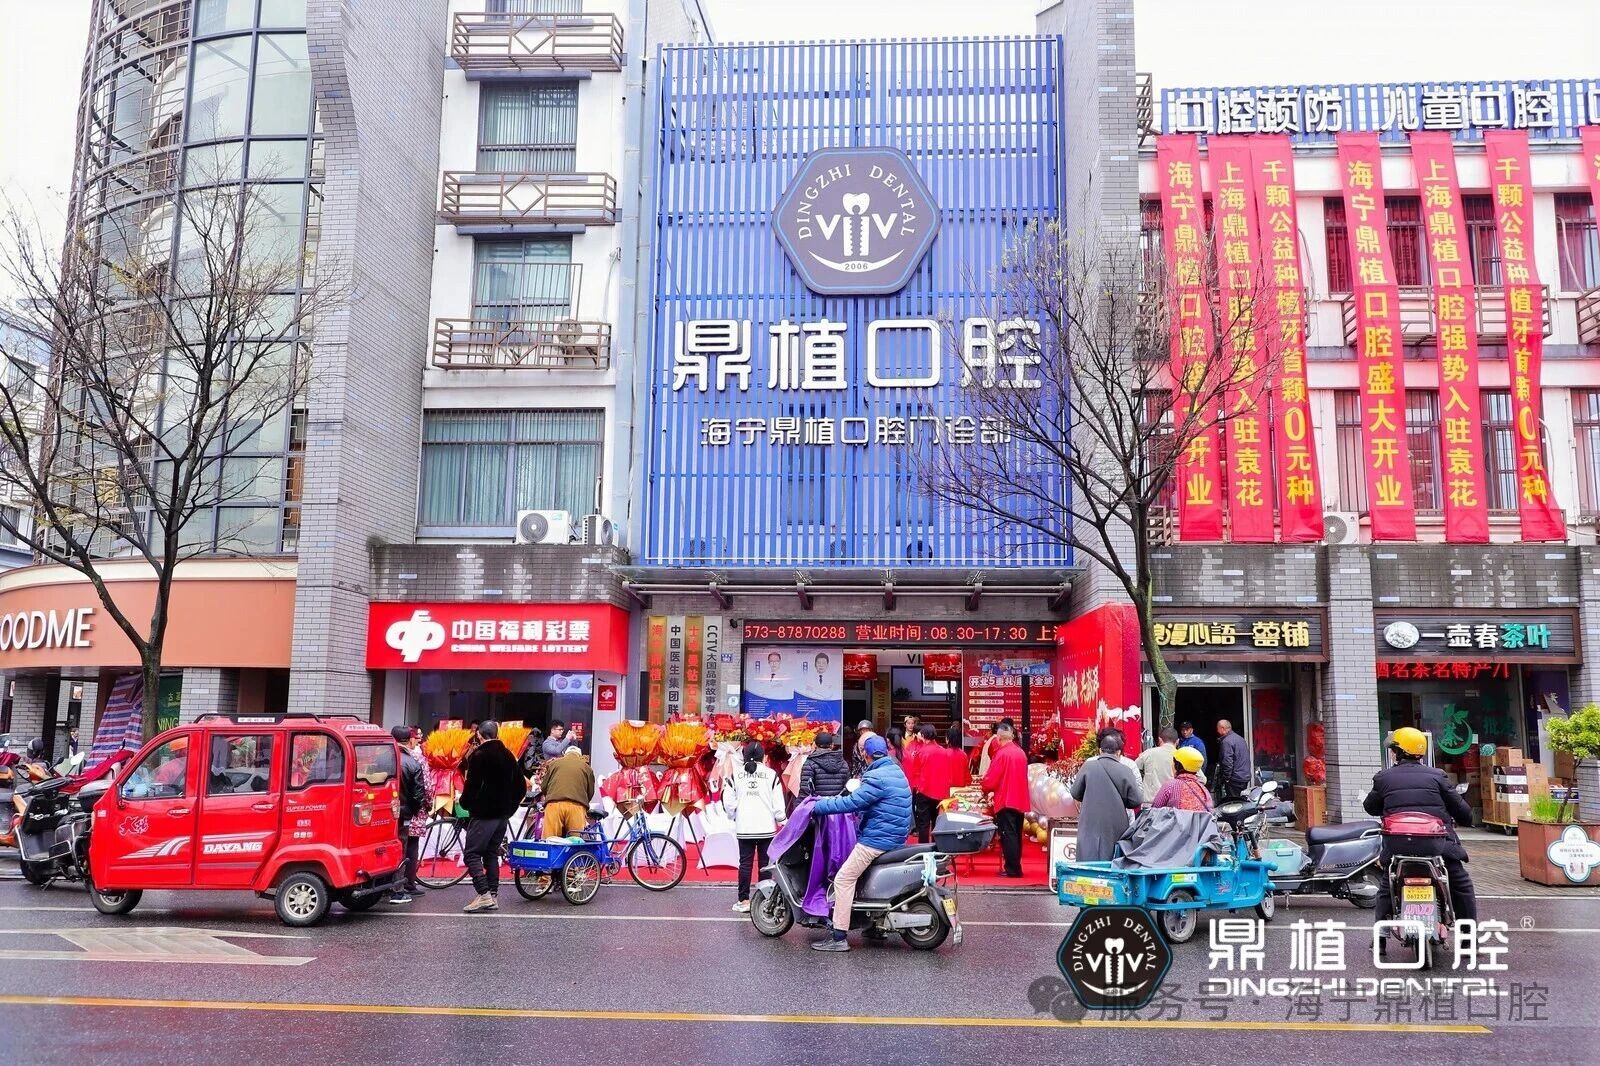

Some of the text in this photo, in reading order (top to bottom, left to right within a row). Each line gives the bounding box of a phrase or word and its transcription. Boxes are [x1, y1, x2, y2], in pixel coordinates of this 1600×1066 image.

[1176, 91, 1343, 134] 口腔预防
[1381, 86, 1554, 131] 儿童口腔
[797, 164, 916, 240] DINGZHI DENTAL
[844, 263, 869, 271] 2006
[1219, 161, 1264, 507] 上海鼎植口腔强势入驻袁花
[1348, 161, 1404, 507] 海宁鼎植口腔盛大开业
[1423, 159, 1478, 507] 上海鼎植口腔强势入驻袁花
[673, 317, 1042, 393] 鼎植口腔
[701, 416, 1013, 447] 海宁鼎植口腔门诊部
[452, 620, 590, 641] 中国福利彩票
[542, 644, 589, 653] LOTTERY
[745, 625, 846, 639] 573-87870288
[1421, 623, 1551, 649] 一壶春茶叶
[668, 625, 681, 716] 中国医生集团联
[203, 842, 264, 855] DAYANG
